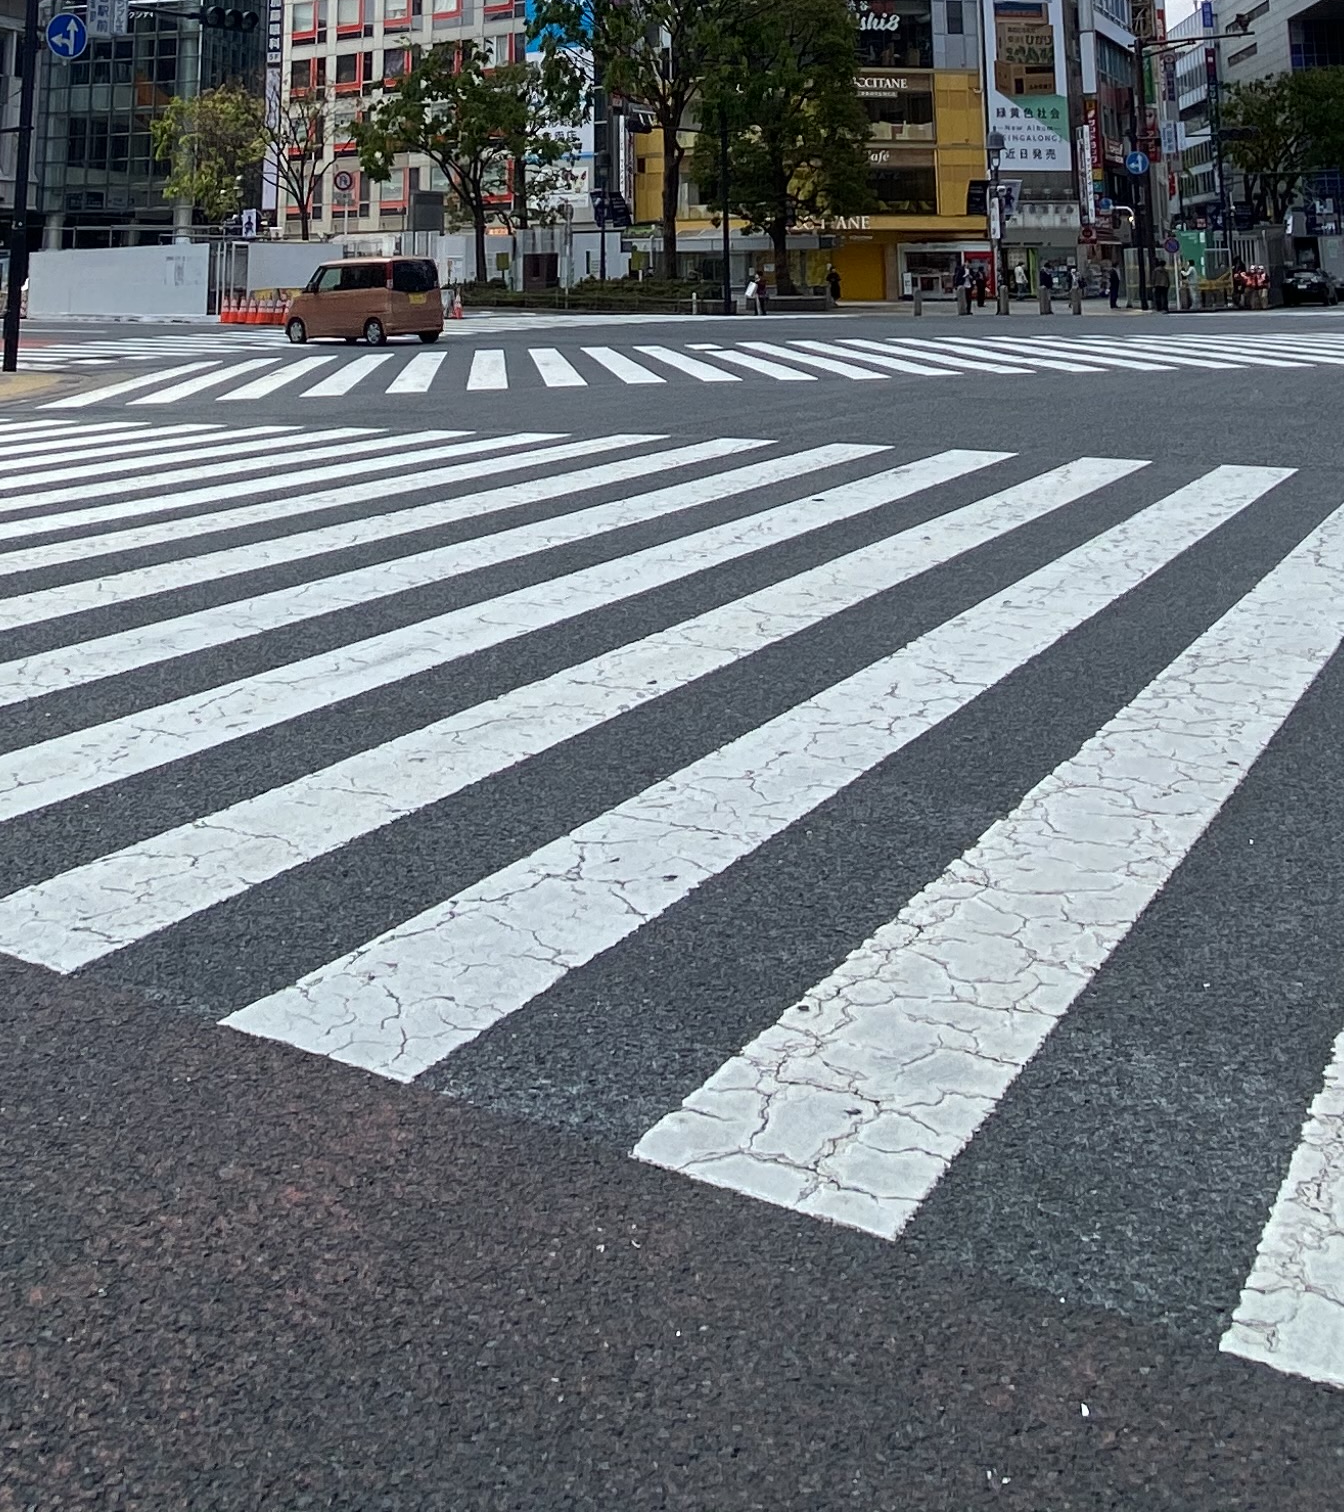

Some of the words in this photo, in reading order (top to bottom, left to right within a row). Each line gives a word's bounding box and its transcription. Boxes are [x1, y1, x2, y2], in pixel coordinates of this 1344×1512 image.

[996, 107, 1060, 119] 緑黄色社会
[1006, 148, 1057, 160] 近日発売
